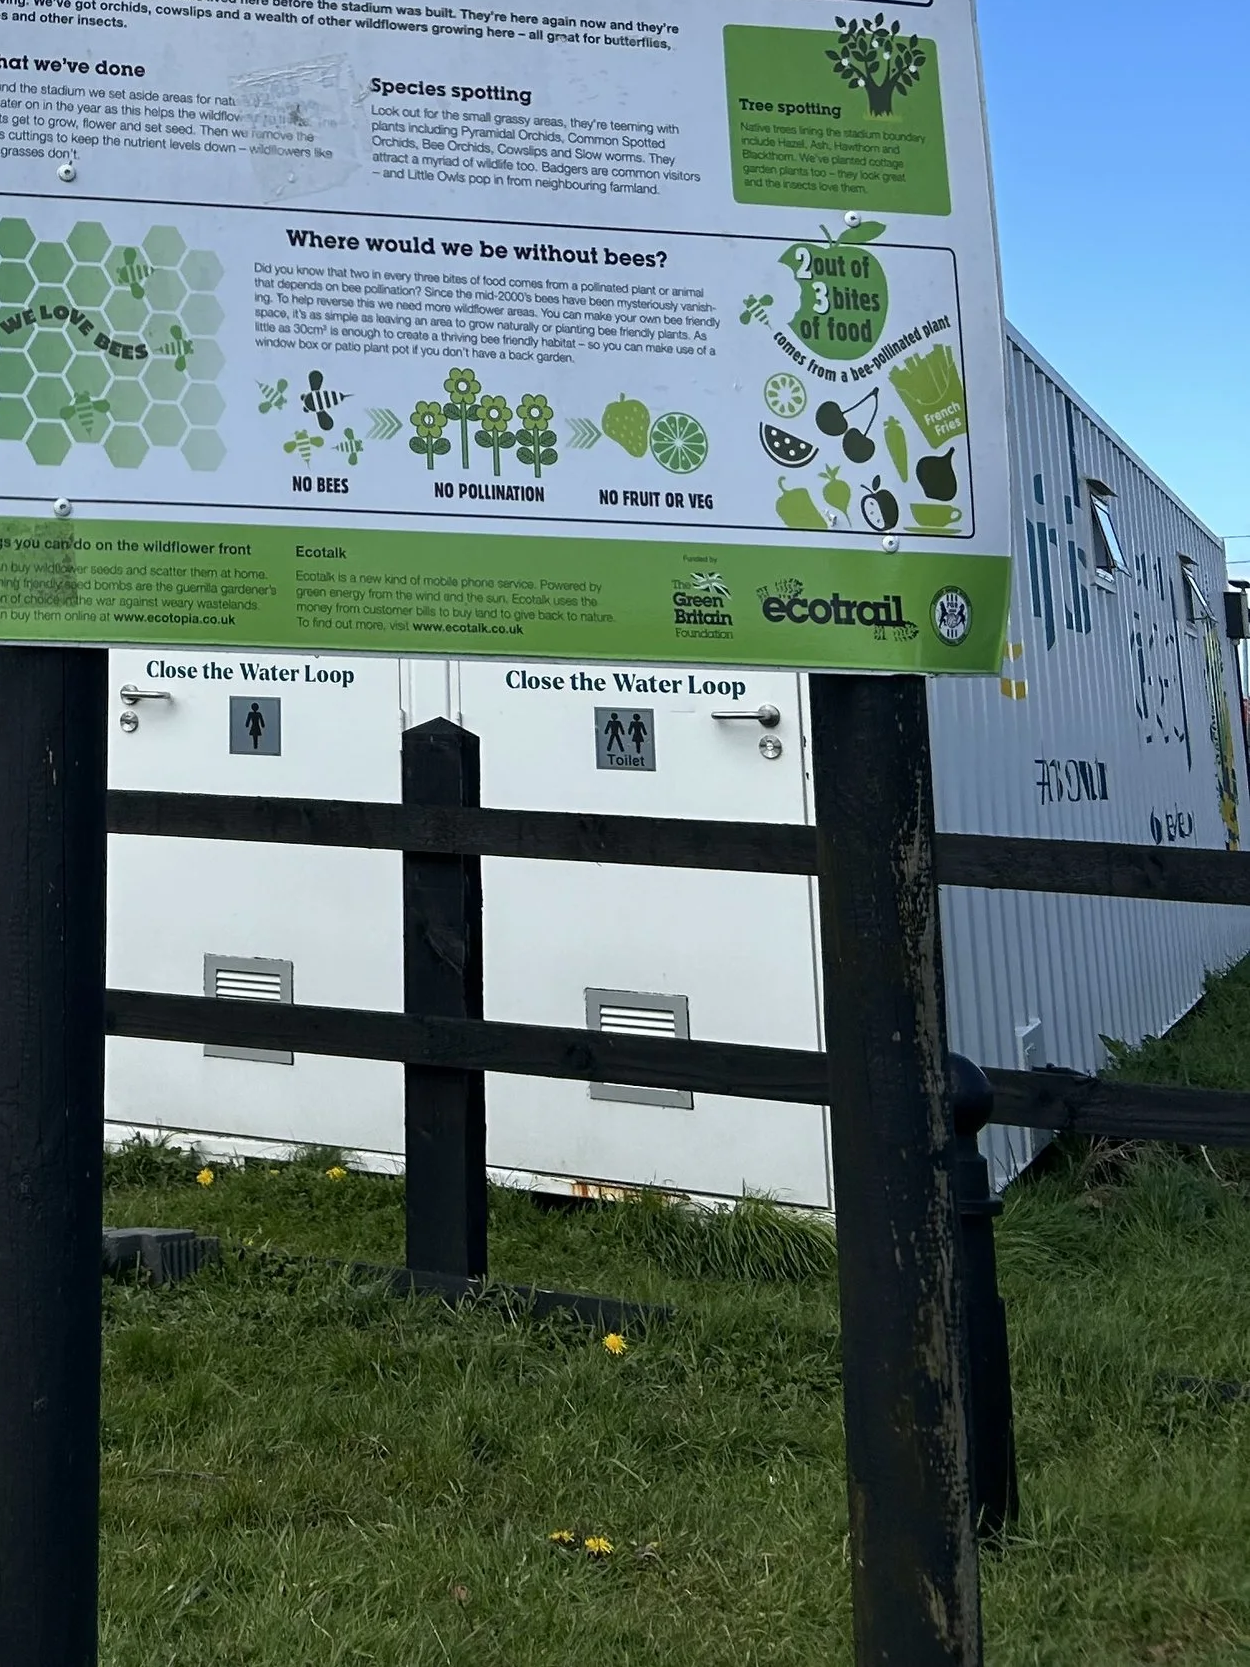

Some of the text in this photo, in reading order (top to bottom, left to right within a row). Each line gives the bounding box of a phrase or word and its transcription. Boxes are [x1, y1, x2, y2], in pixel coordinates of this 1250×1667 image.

[11, 11, 36, 22] and
[39, 12, 74, 24] other
[77, 14, 127, 28] insects.
[75, 0, 96, 11] got
[100, 1, 151, 15] orchids,
[155, 5, 212, 19] cowslips
[215, 9, 240, 20] and
[243, 11, 251, 20] a
[254, 11, 297, 23] wealth
[301, 14, 314, 24] of
[317, 15, 352, 27] other
[355, 17, 428, 32] wildflowers
[431, 24, 483, 38] growing
[486, 26, 515, 38] here
[528, 29, 543, 40] all
[582, 33, 601, 44] for
[316, 0, 338, 10] the
[341, 1, 392, 14] stadium
[395, 6, 422, 16] was
[425, 6, 456, 18] built.
[459, 8, 507, 23] They're
[510, 12, 538, 24] here
[541, 16, 576, 28] again
[579, 19, 606, 29] now
[609, 20, 633, 31] and
[636, 21, 679, 35] they're
[33, 57, 89, 74] we've
[94, 60, 145, 77] done
[369, 77, 532, 106] Species spotting
[738, 98, 841, 119] Tree spotting
[0, 147, 45, 158] grasses
[47, 147, 79, 162] don't.
[286, 229, 667, 268] Where would we be without bees?
[795, 247, 869, 279] 2 out of
[811, 281, 880, 314] 3 bites
[0, 304, 148, 360] WE LOVE BEES
[800, 316, 872, 342] of food
[773, 313, 952, 384] comes from a bee-pollinated plant
[922, 400, 962, 427] French
[933, 416, 962, 437] Fries
[292, 475, 349, 494] NO BEES
[434, 482, 544, 502] NO POLLINATION
[598, 489, 713, 509] NO FRUIT OR VEG
[15, 539, 40, 550] you
[44, 540, 70, 550] can
[73, 537, 91, 550] do
[95, 541, 112, 551] on
[117, 539, 139, 551] the
[143, 540, 215, 554] wildflower
[218, 542, 251, 555] front
[295, 545, 347, 559] Ecotalk
[671, 579, 694, 590] The
[672, 591, 726, 608] Green
[10, 610, 30, 622] buy
[34, 611, 61, 621] them
[64, 611, 96, 622] online
[113, 612, 235, 626] www.ecotopia.co.uk
[673, 608, 733, 626] Britain
[762, 595, 904, 627] ecotrail
[312, 617, 332, 628] find
[335, 619, 352, 629] out
[355, 621, 385, 630] more,
[389, 622, 409, 631] visit
[412, 622, 523, 635] www.ecotalk.co.uk
[675, 627, 733, 639] Foundation
[147, 661, 354, 687] Close the Water Loop
[506, 670, 745, 700] Close the Water Loop
[606, 752, 646, 768] Toilet
